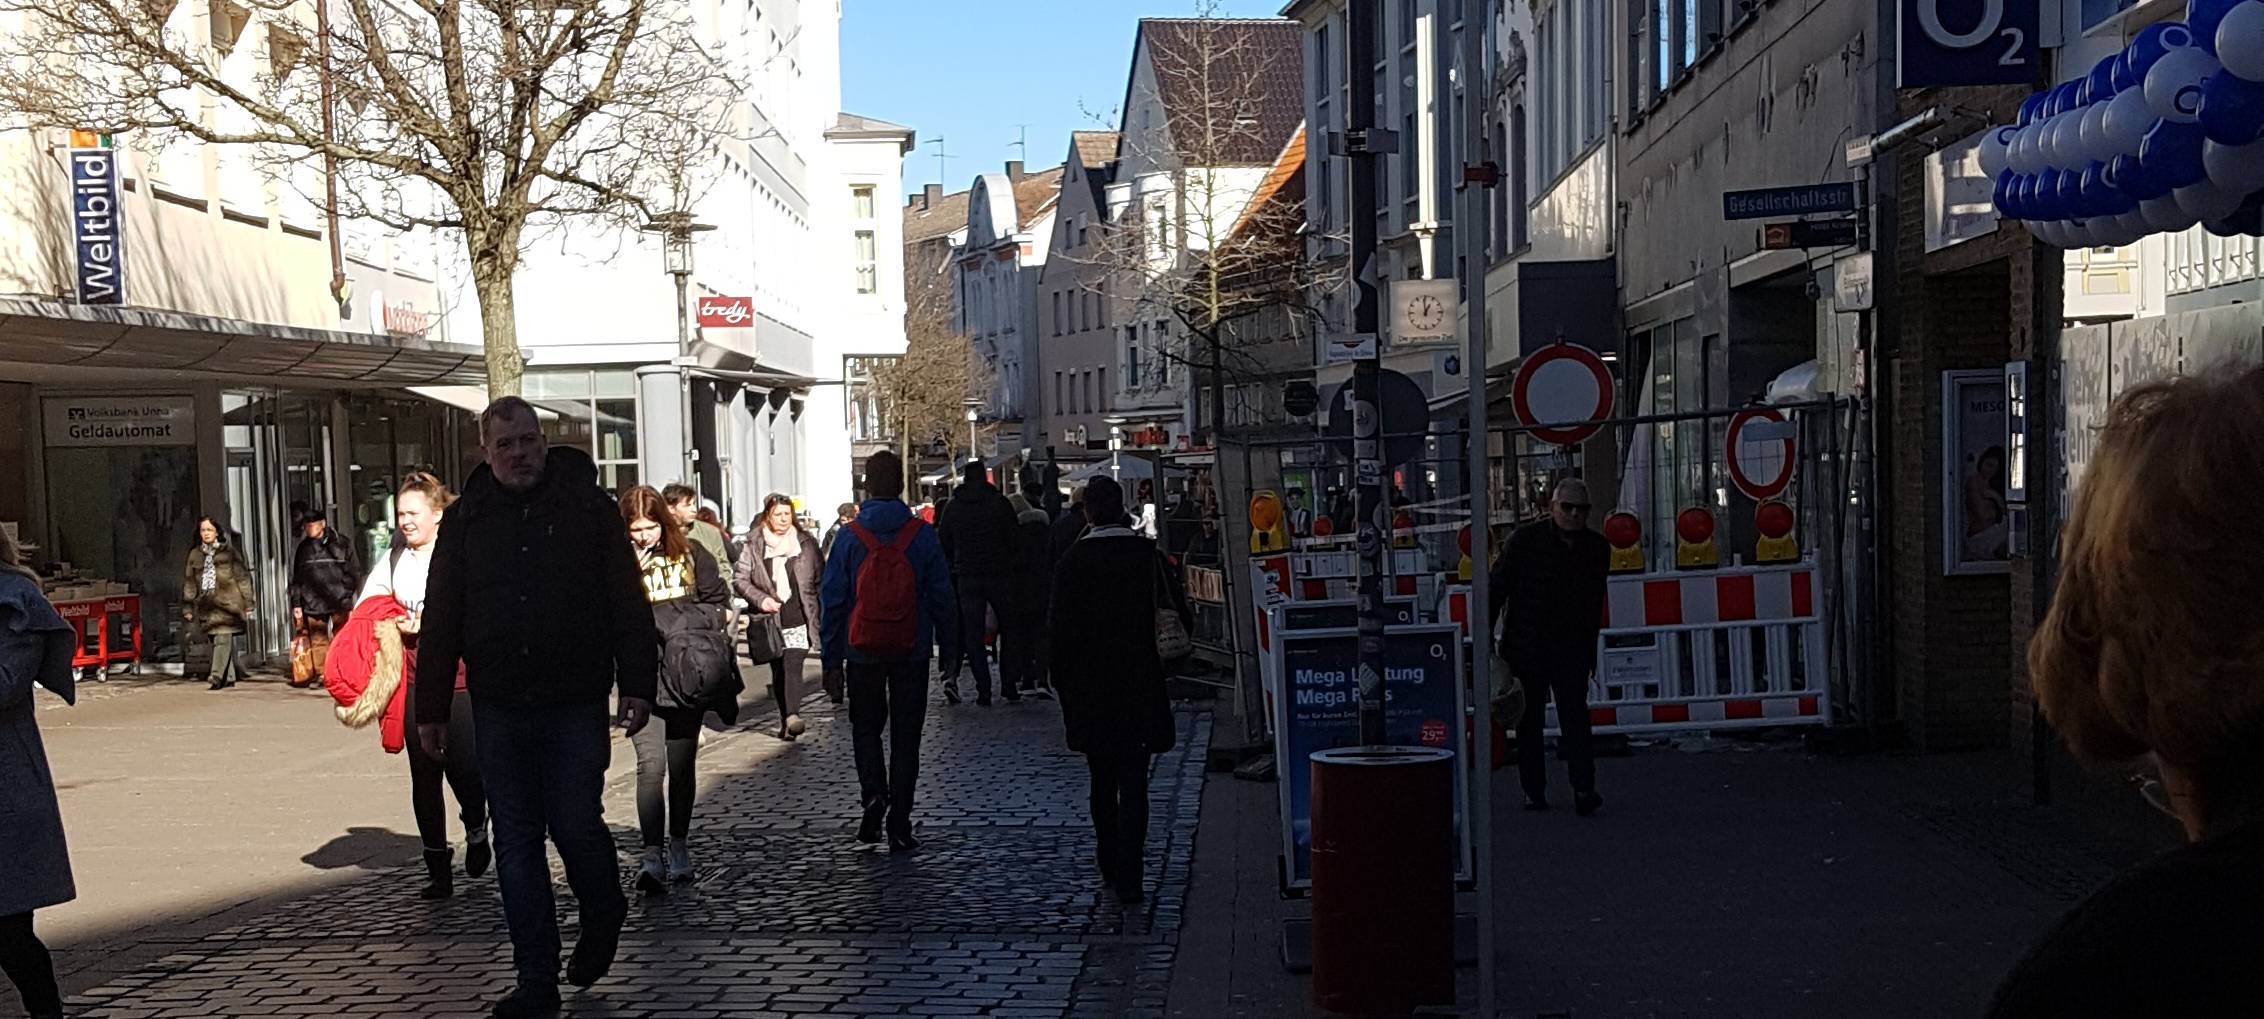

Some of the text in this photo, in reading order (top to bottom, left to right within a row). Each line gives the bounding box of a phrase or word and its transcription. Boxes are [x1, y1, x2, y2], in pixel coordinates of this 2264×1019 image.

[78, 155, 115, 300] Weltbild
[701, 300, 751, 323] tredy
[142, 406, 169, 416] Unna
[69, 424, 171, 439] Geldautomat
[1429, 643, 1447, 661] O2
[1296, 666, 1425, 687] Mega Ltung
[1296, 690, 1347, 708] Mega
